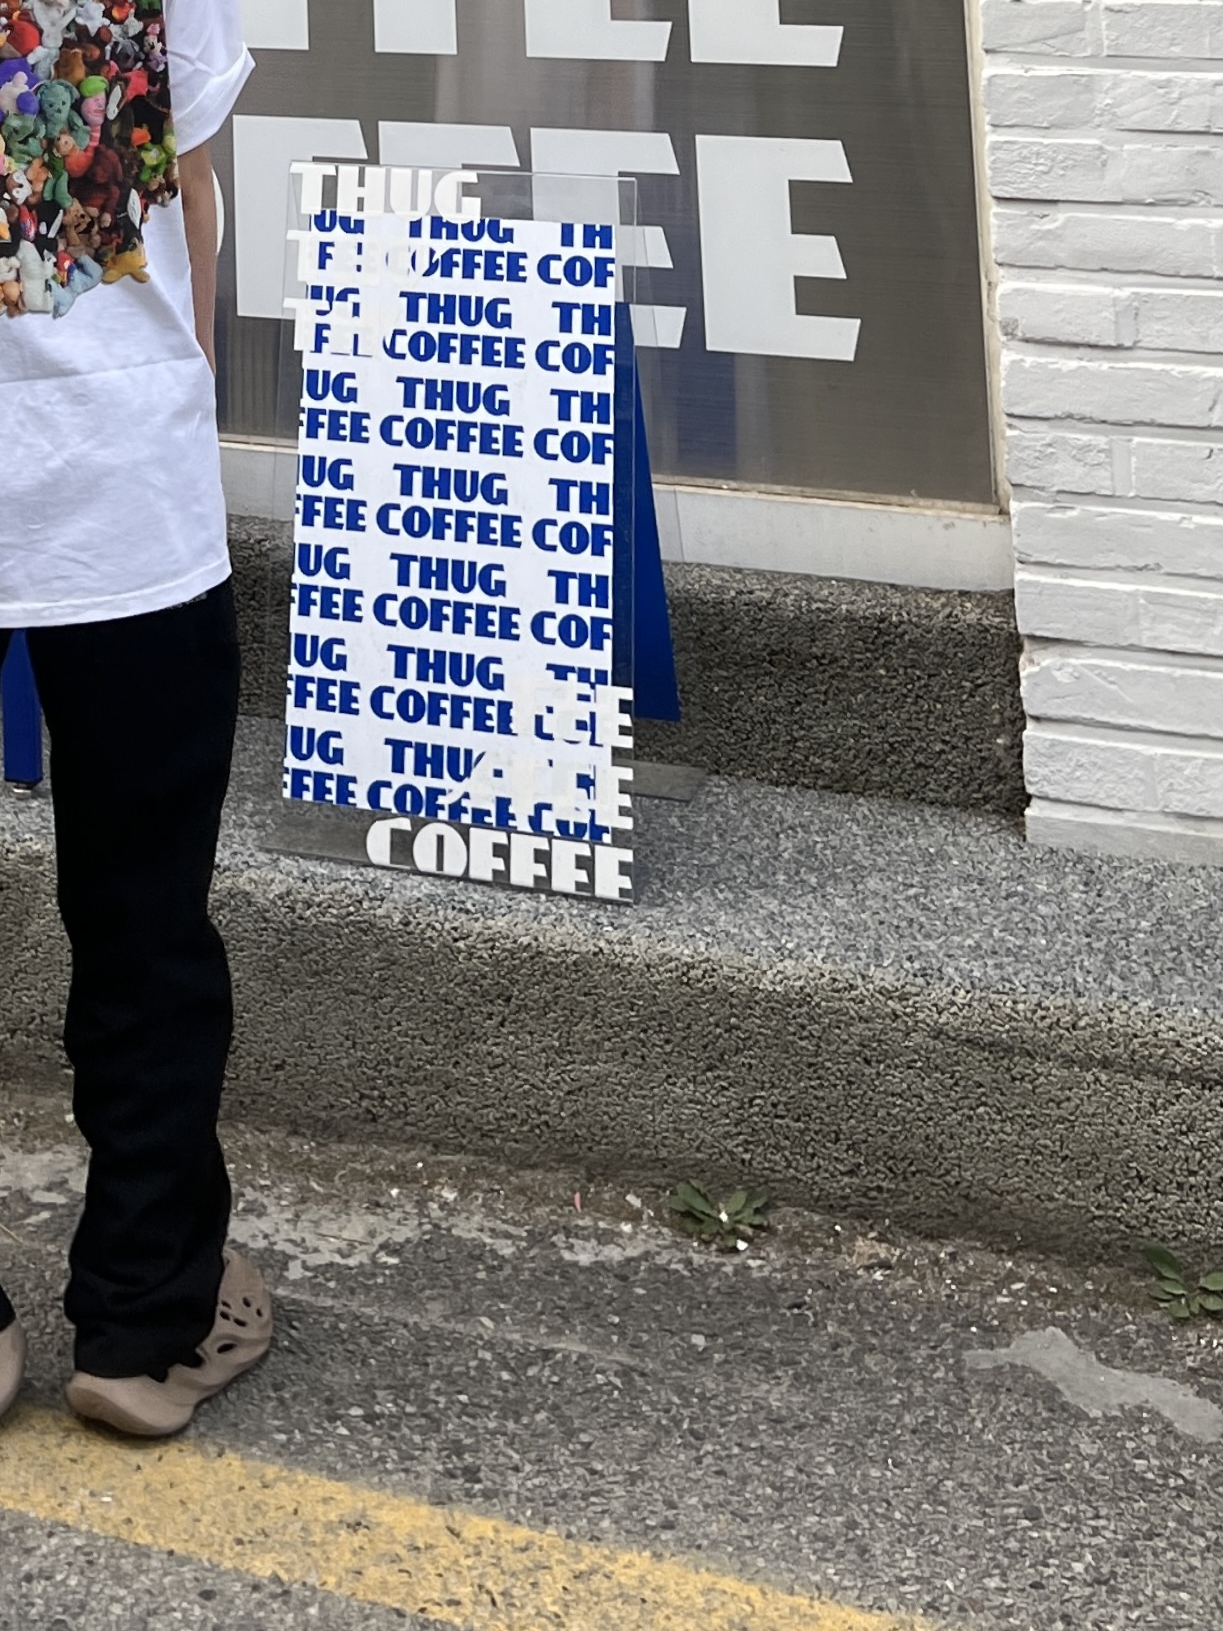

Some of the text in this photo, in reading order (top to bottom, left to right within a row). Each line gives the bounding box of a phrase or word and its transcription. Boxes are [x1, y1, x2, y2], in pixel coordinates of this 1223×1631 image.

[289, 160, 482, 224] THUG
[537, 254, 616, 288] COF
[398, 290, 513, 330] THUG
[551, 301, 612, 337] TH
[535, 340, 616, 376] COF
[395, 376, 511, 417] THUG
[550, 388, 611, 425] TH
[299, 406, 614, 465] FEE COFFEE COF
[298, 454, 610, 516] UG THUG TH
[295, 493, 614, 557] FEE COFFEE COF
[389, 552, 507, 598] THUG
[547, 569, 609, 609] TH
[290, 582, 613, 651] FEE COFFEE COF
[386, 644, 505, 692] THUG
[286, 673, 362, 716] FEE
[384, 737, 487, 783] THU
[283, 767, 358, 806] FEE
[366, 816, 634, 904] COFFEE
